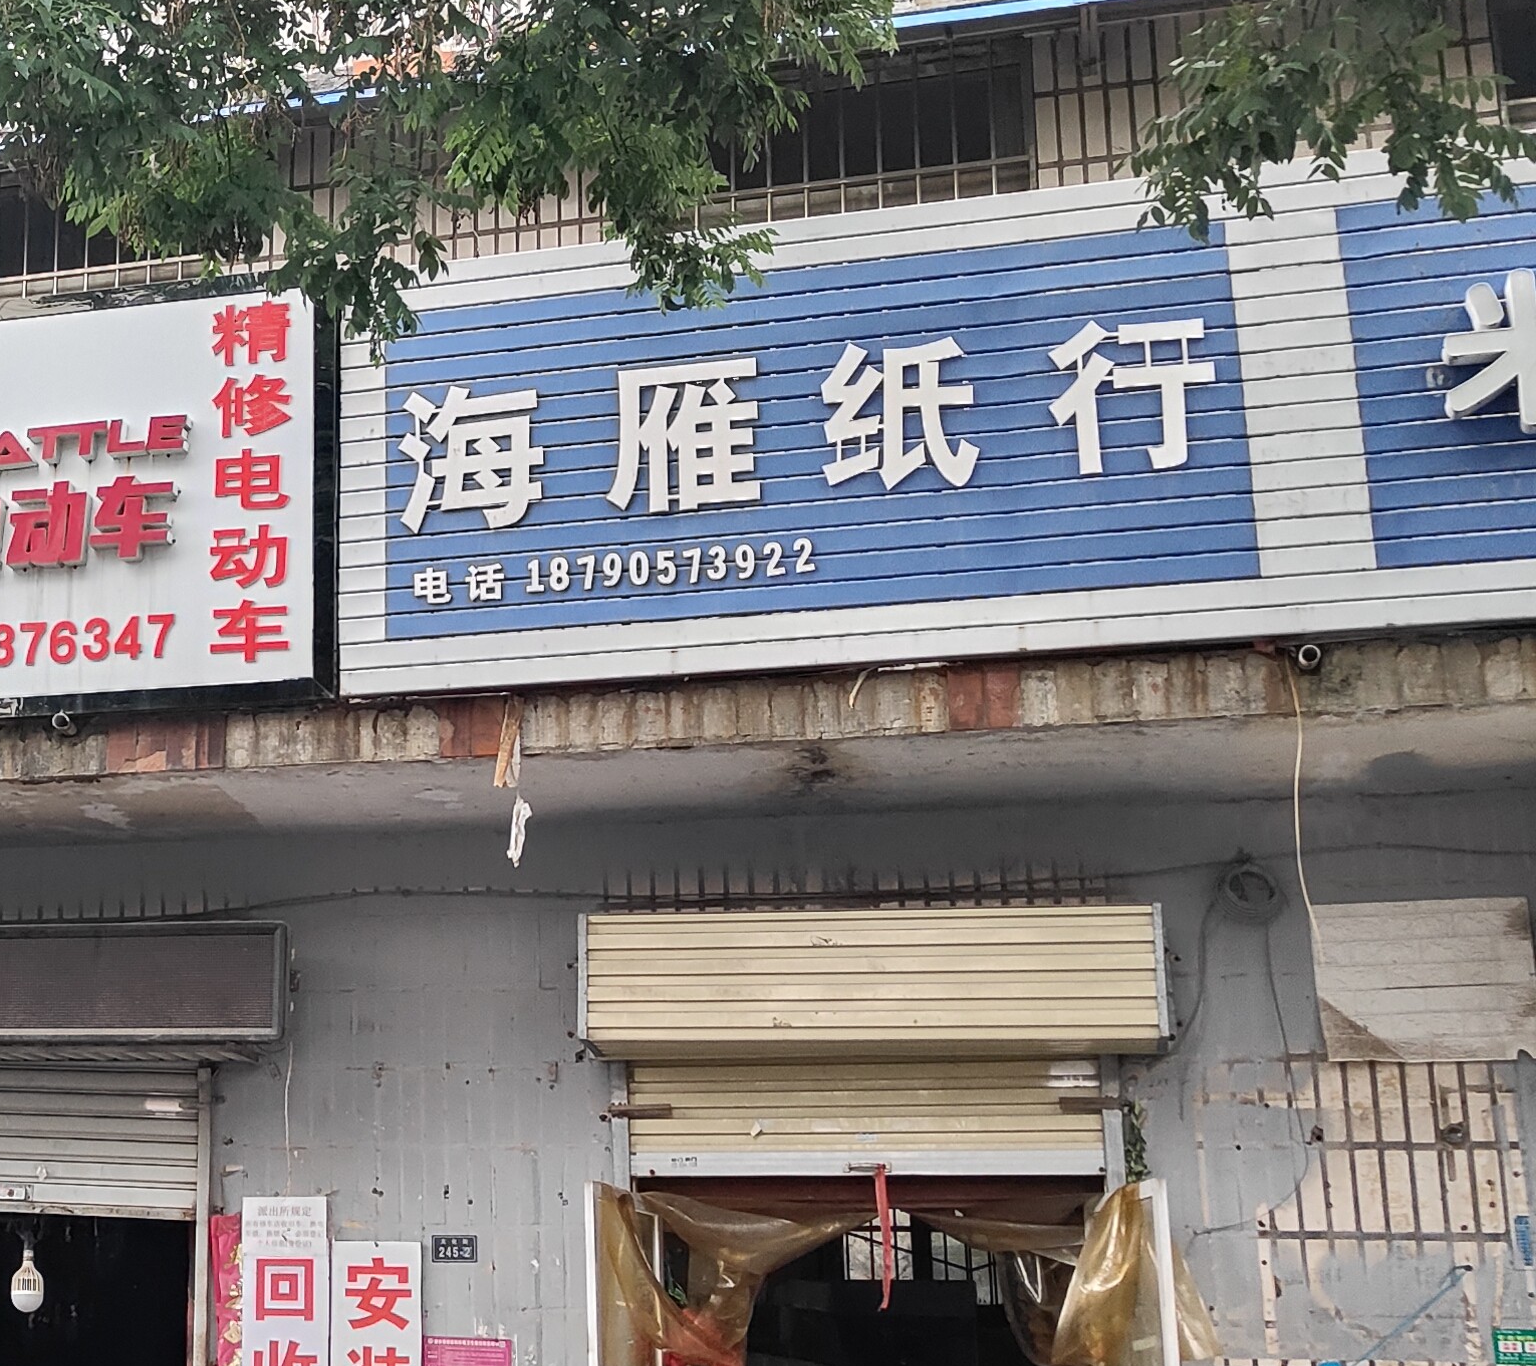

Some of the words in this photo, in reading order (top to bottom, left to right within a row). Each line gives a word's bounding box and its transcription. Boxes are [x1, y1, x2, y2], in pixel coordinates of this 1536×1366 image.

[210, 300, 292, 665] 精修电动车
[397, 319, 1216, 534] 海雁纸行
[413, 561, 505, 605] 电话
[525, 537, 817, 594] 18790573922
[438, 1246, 472, 1258] 245-2
